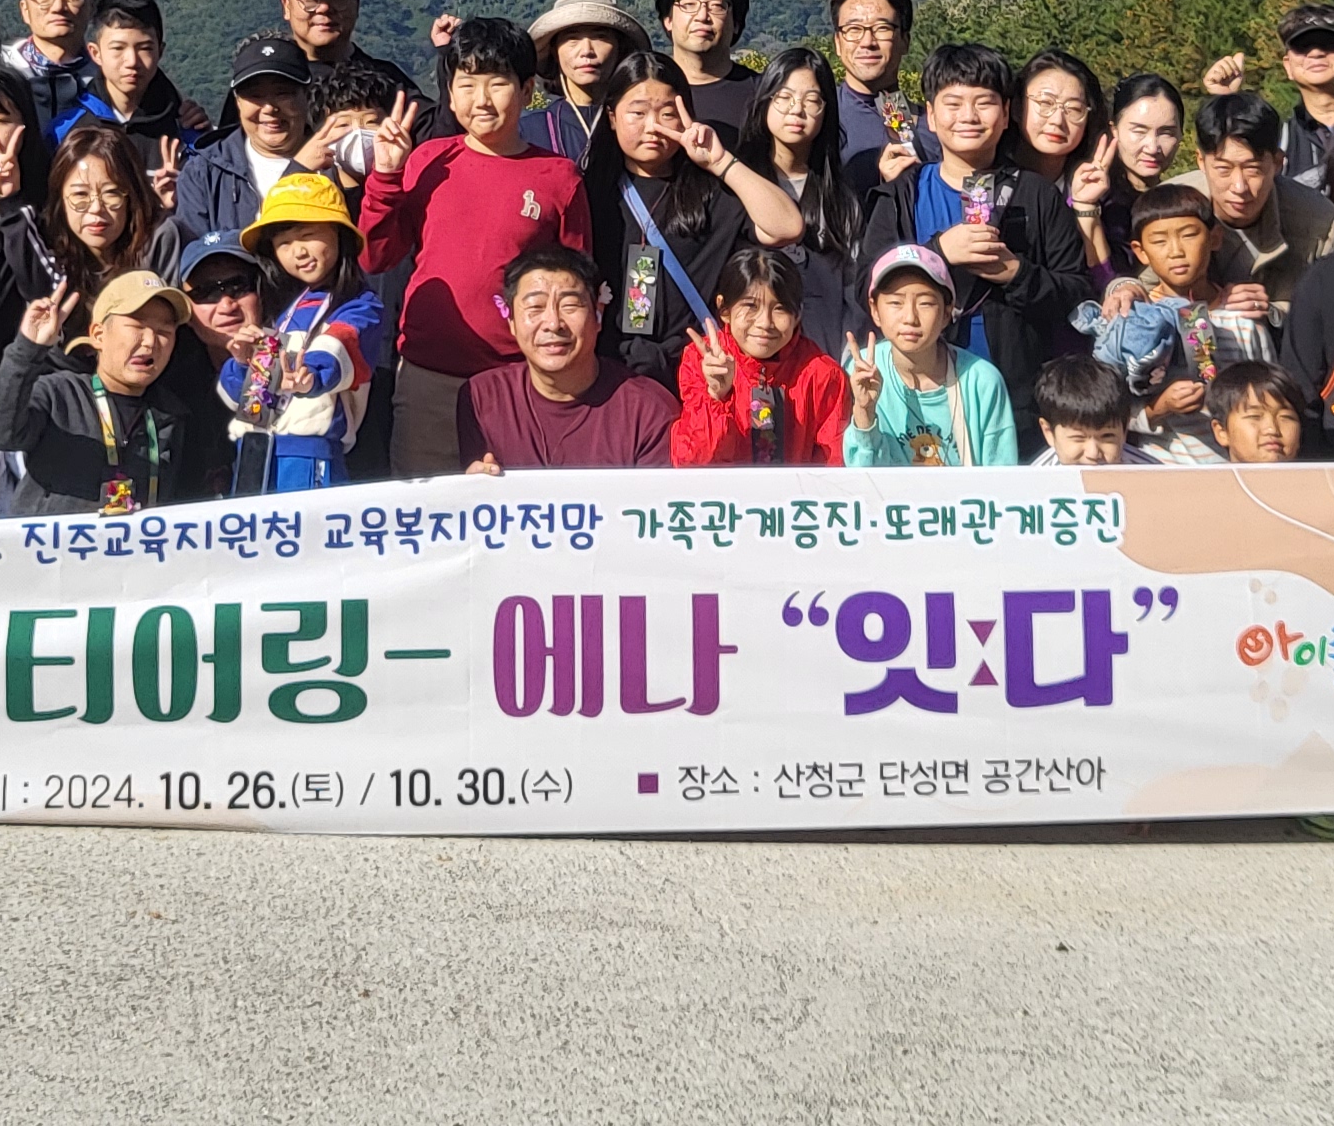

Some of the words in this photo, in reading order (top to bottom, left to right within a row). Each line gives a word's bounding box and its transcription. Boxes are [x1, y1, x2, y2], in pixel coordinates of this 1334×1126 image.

[21, 510, 302, 565] 진주교육지원청
[323, 502, 604, 557] 교육복지안전망
[492, 592, 739, 719] 에나
[44, 774, 145, 810] 2024.
[160, 771, 213, 811] 10.
[359, 772, 375, 806] /
[389, 769, 443, 807] 10.
[677, 765, 741, 801] 장소
[773, 761, 867, 799] 산청군
[879, 759, 970, 797] 단성면
[981, 755, 1108, 794] 공간산아
